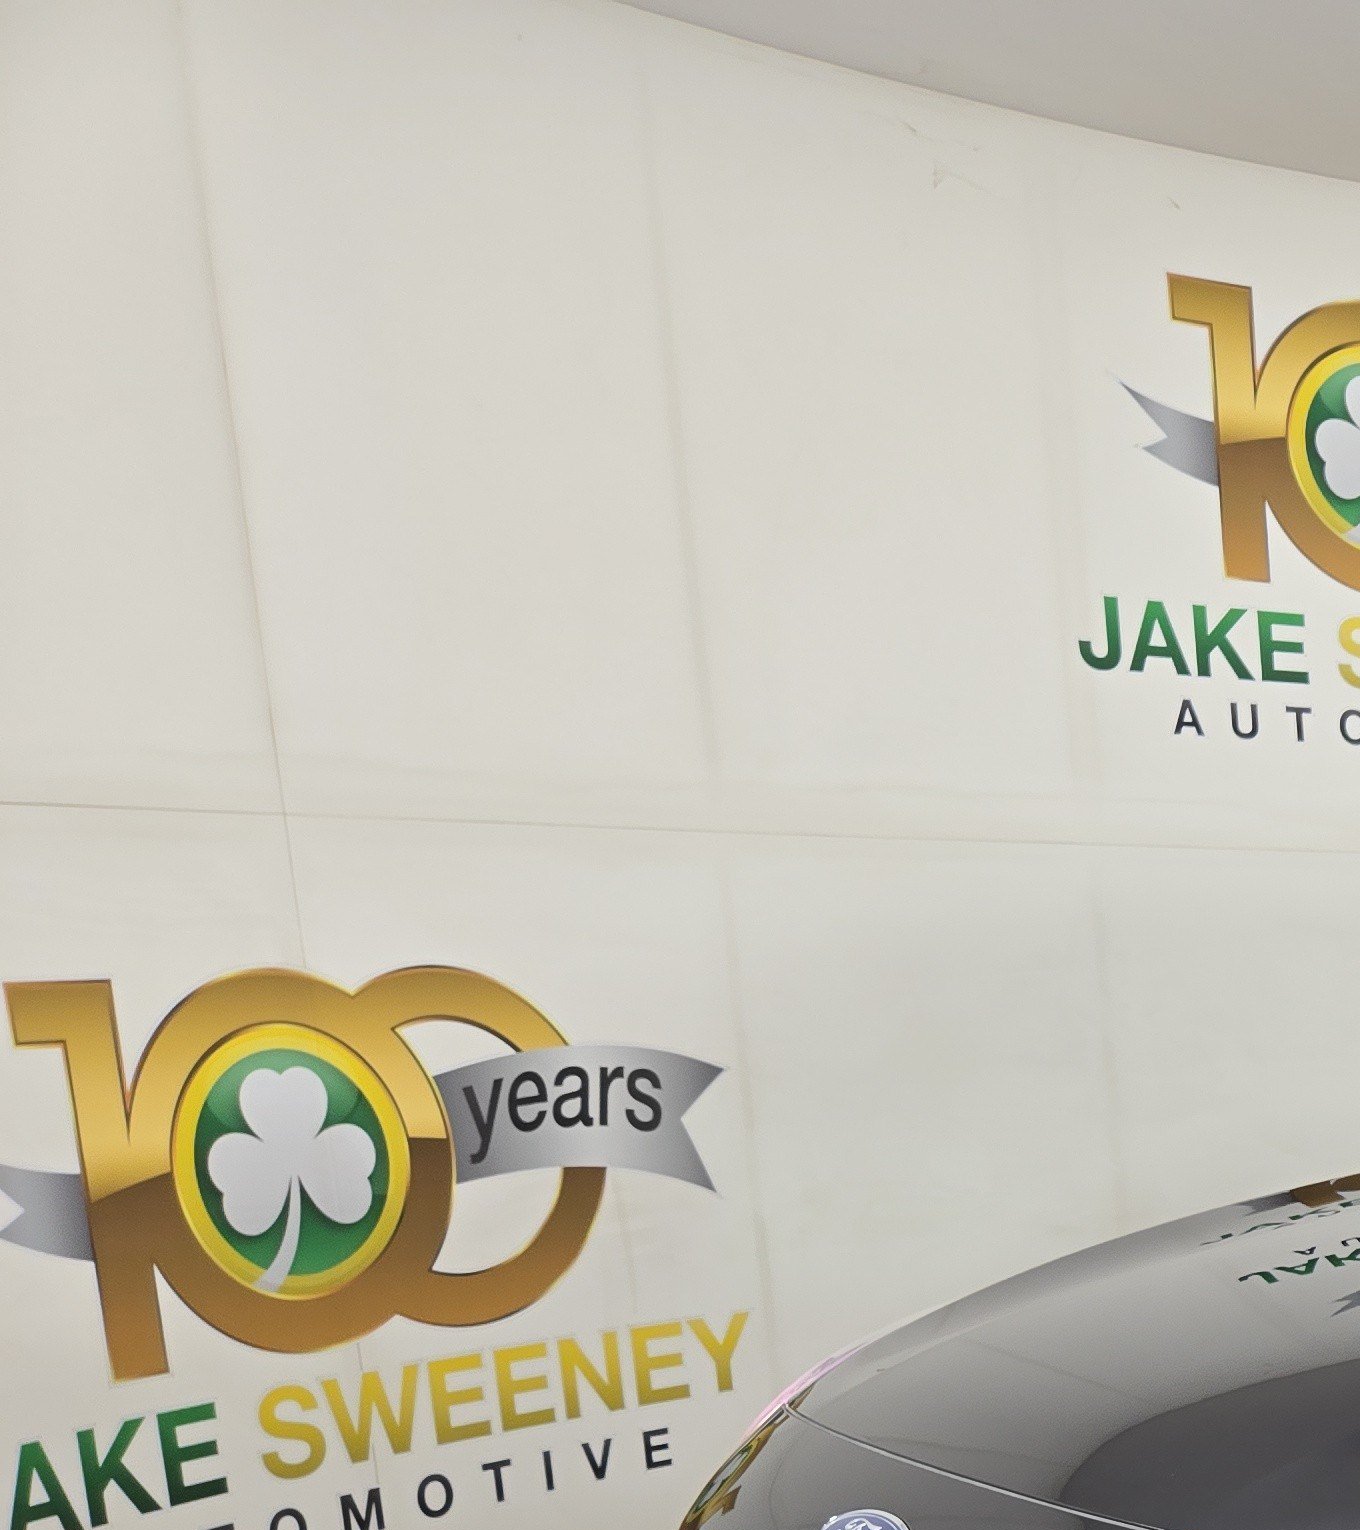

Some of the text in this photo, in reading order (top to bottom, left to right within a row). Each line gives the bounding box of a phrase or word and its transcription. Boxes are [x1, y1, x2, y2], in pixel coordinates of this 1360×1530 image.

[1077, 595, 1310, 685] JAKE
[3, 965, 663, 1382] 100 years
[257, 1312, 749, 1479] SWEENEY
